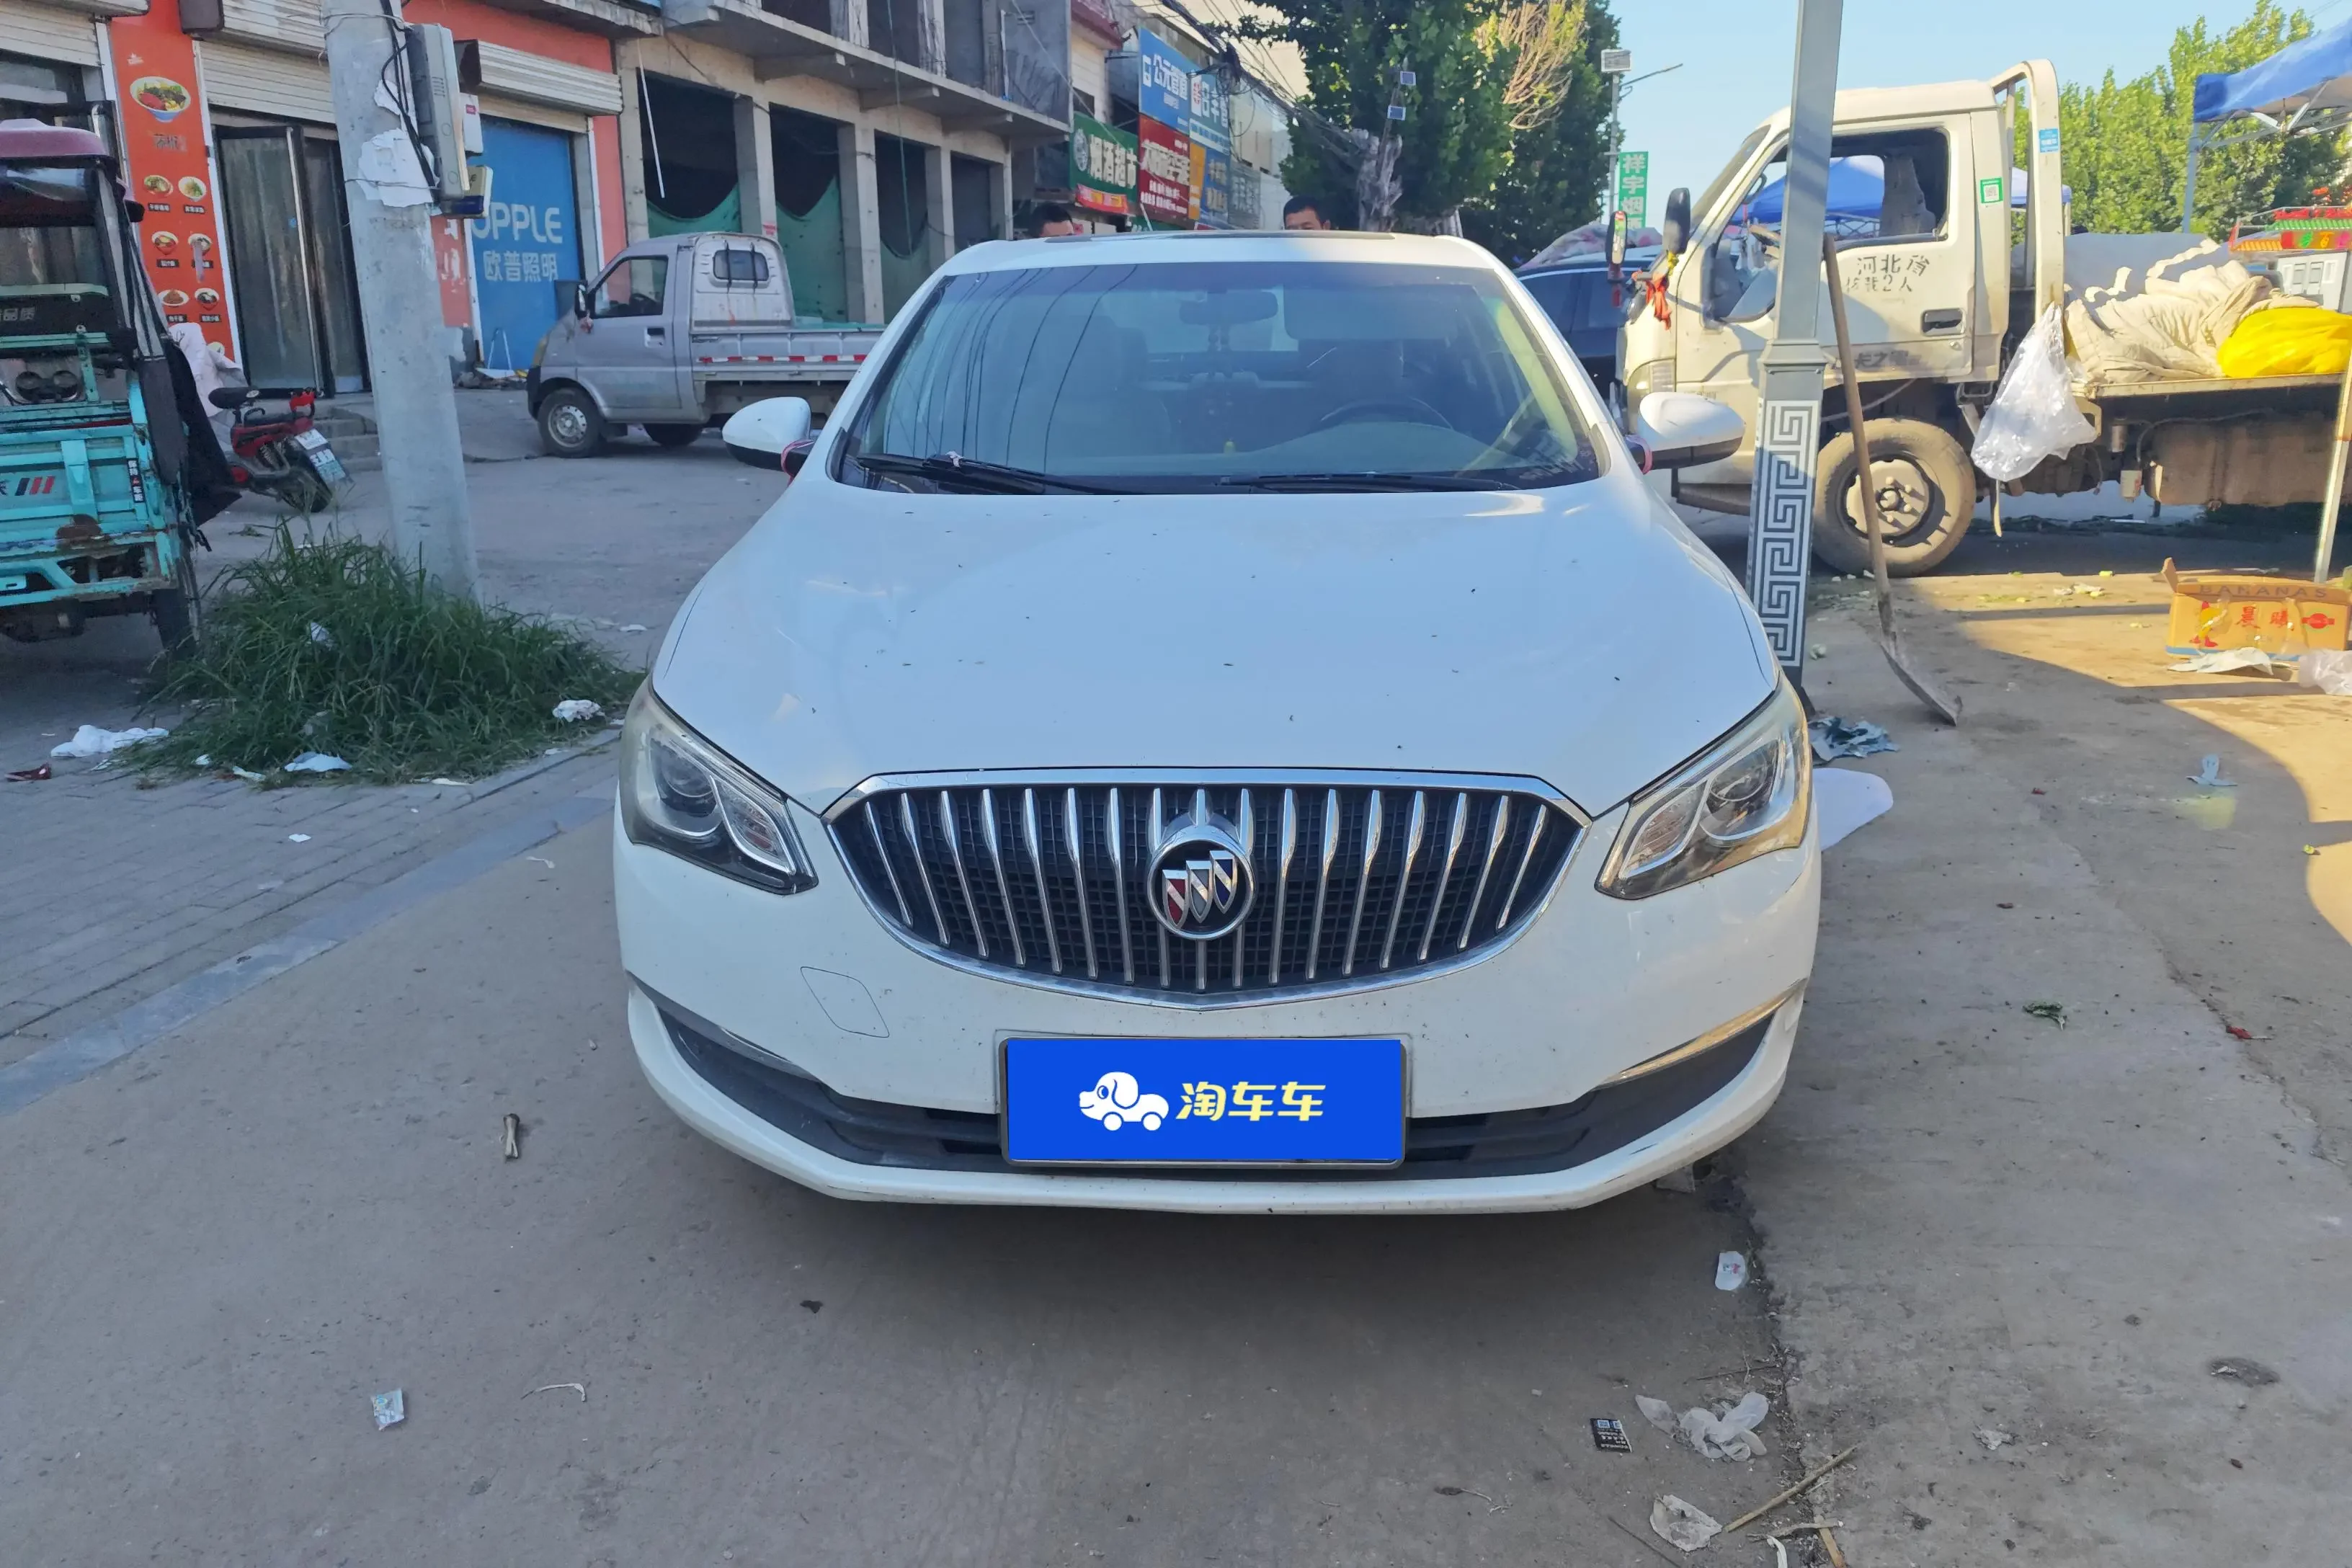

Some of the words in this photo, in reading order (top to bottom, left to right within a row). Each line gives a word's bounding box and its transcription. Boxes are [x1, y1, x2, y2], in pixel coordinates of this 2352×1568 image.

[1089, 134, 1137, 189] 烟酒超市
[482, 249, 558, 283] 欧普照明
[1857, 254, 1930, 277] 河北省
[2199, 585, 2327, 598] BANANAS
